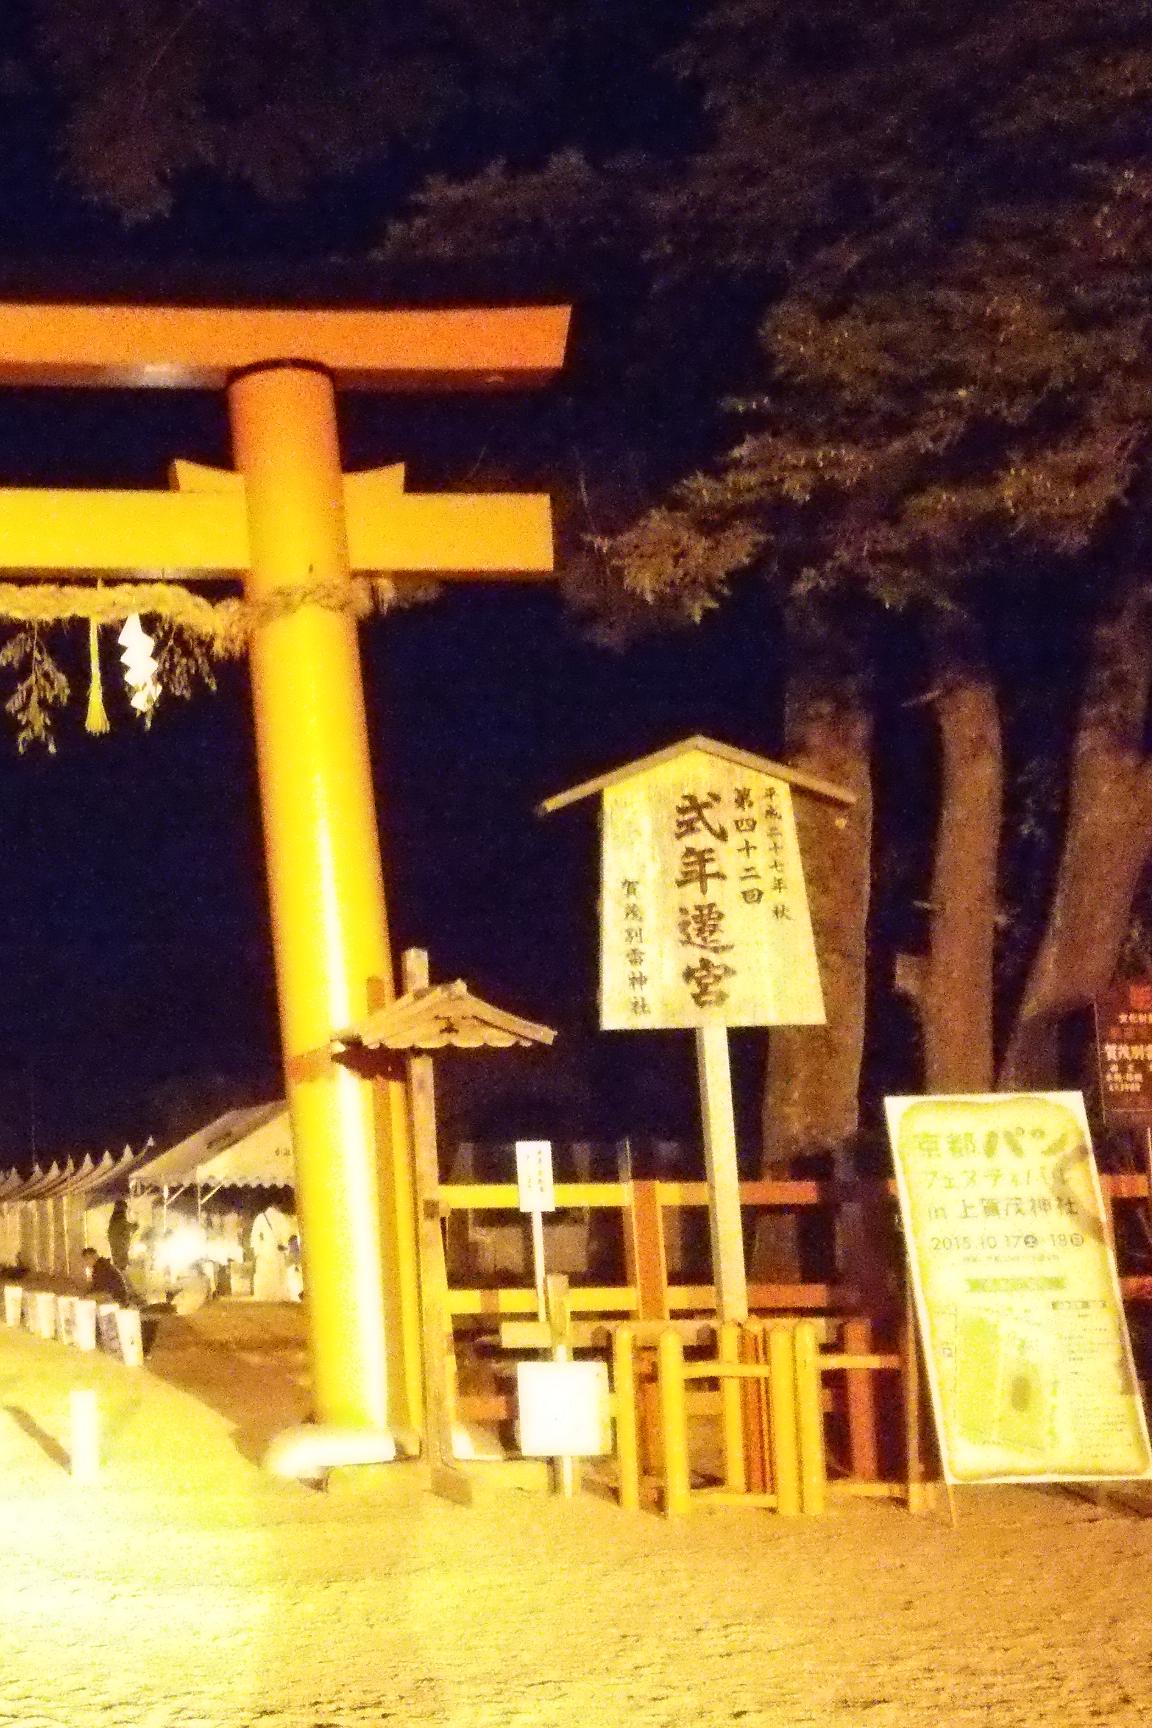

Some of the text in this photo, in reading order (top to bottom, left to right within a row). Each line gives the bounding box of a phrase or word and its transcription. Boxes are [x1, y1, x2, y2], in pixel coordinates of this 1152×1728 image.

[674, 791, 737, 1009] 式年遷宮
[733, 786, 764, 905] 第四十二回
[620, 878, 652, 1016] 賀茂別雷神社
[914, 1126, 1069, 1160] 京都パン
[959, 1197, 1079, 1220] 上賀茂神社
